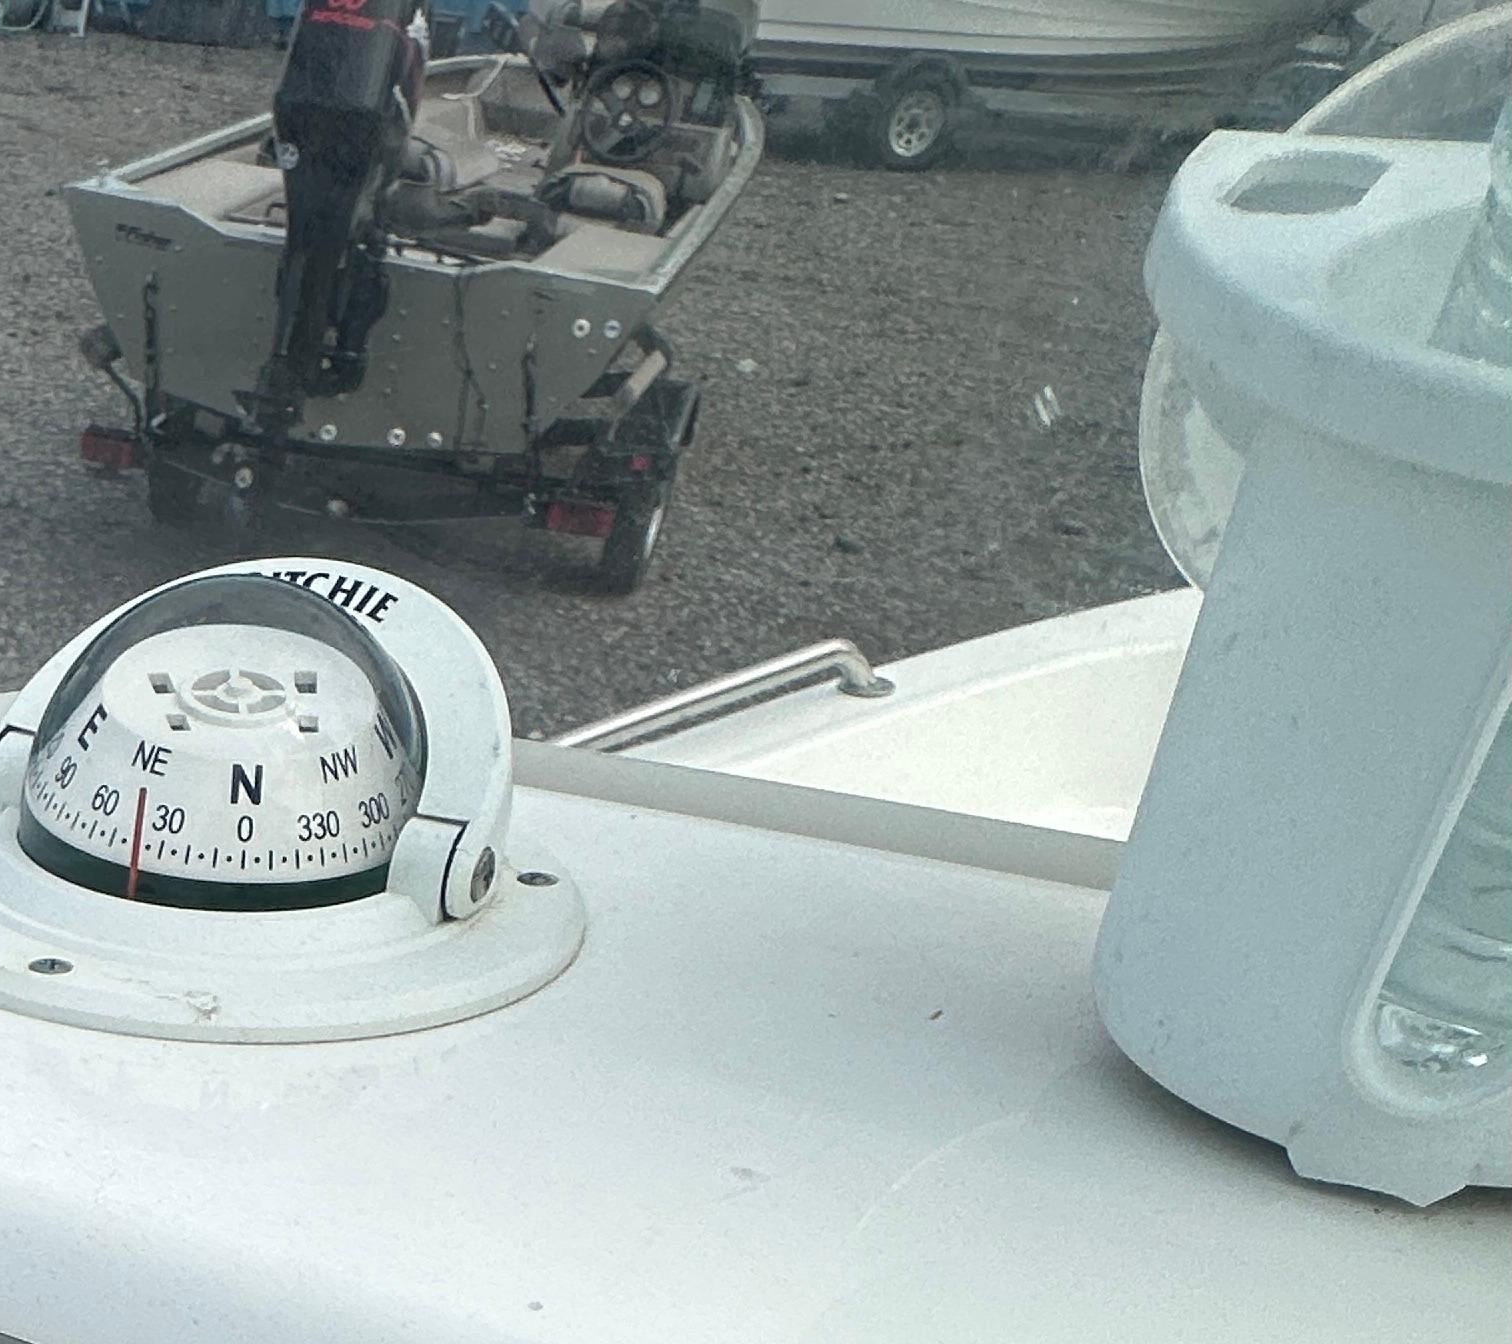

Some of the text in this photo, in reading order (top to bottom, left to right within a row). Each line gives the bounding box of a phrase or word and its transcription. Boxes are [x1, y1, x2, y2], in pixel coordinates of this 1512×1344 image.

[77, 703, 108, 751] E
[131, 739, 173, 777] NE
[319, 745, 358, 784] NW
[91, 784, 120, 816] 60
[230, 763, 264, 805] N
[152, 804, 185, 834] 30
[297, 810, 340, 842] 330
[358, 792, 390, 828] 300
[237, 815, 254, 843] 0
